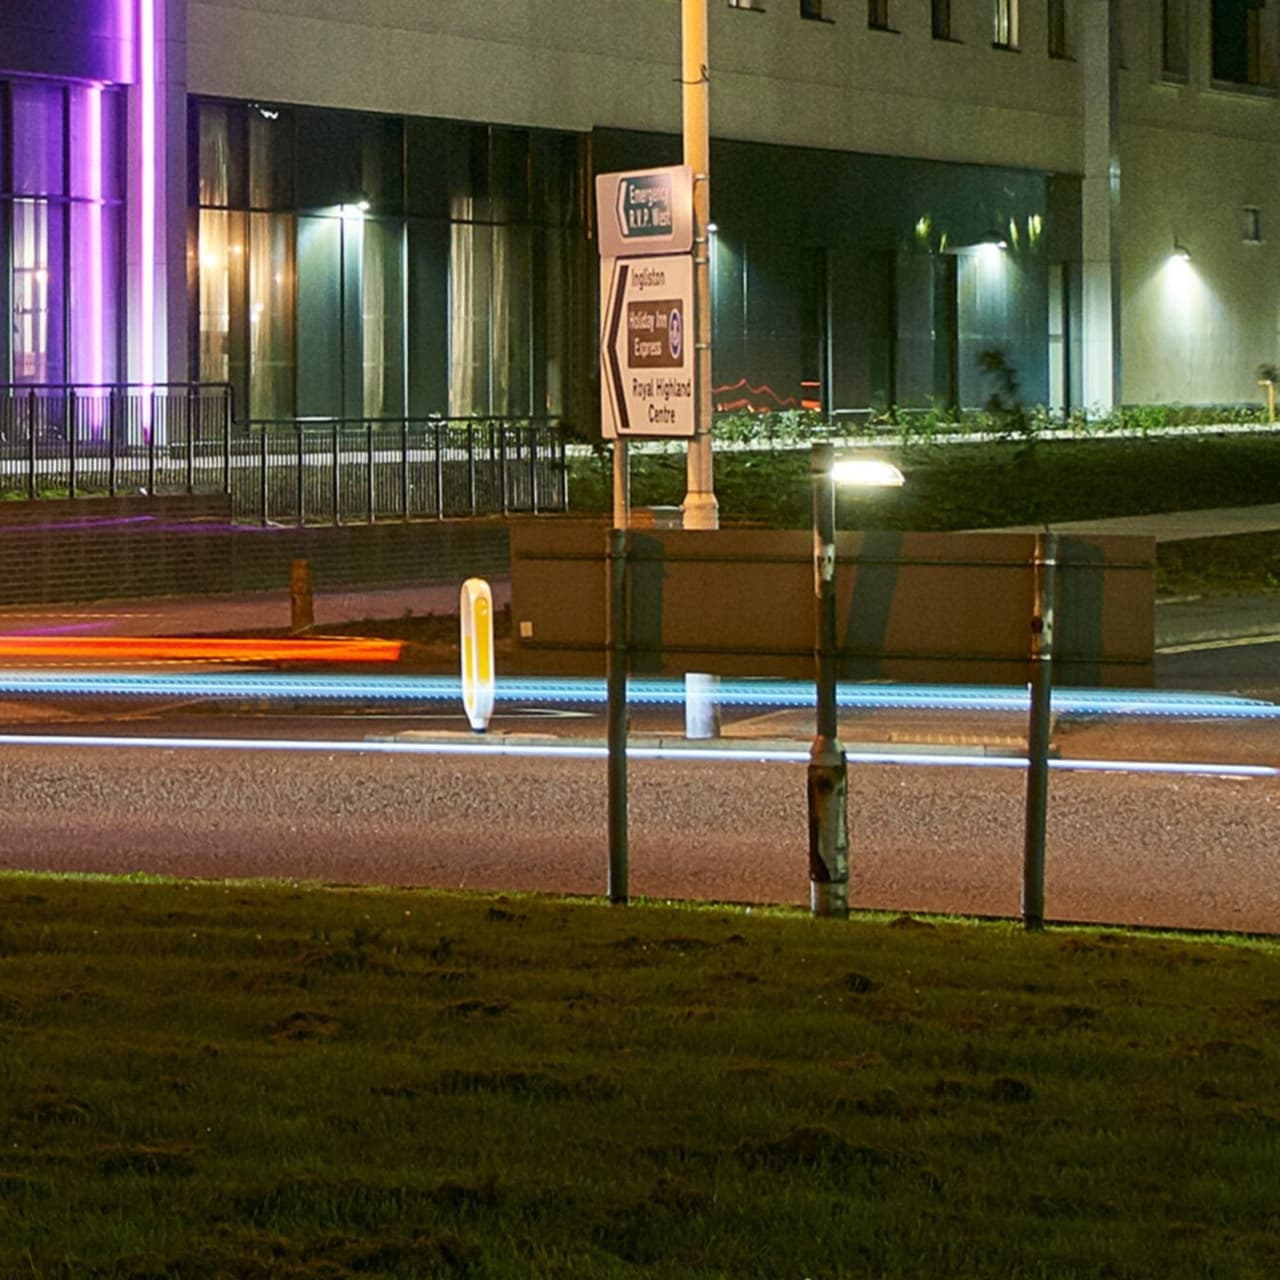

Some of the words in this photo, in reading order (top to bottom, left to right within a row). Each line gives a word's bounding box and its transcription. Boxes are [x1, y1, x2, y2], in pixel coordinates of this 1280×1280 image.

[631, 267, 666, 291] Ingliston
[628, 311, 655, 334] Holiday
[656, 309, 668, 329] Inn
[634, 337, 662, 358] Express
[632, 377, 654, 401] Royal
[656, 376, 692, 401] Highland
[648, 403, 676, 424] Centre
